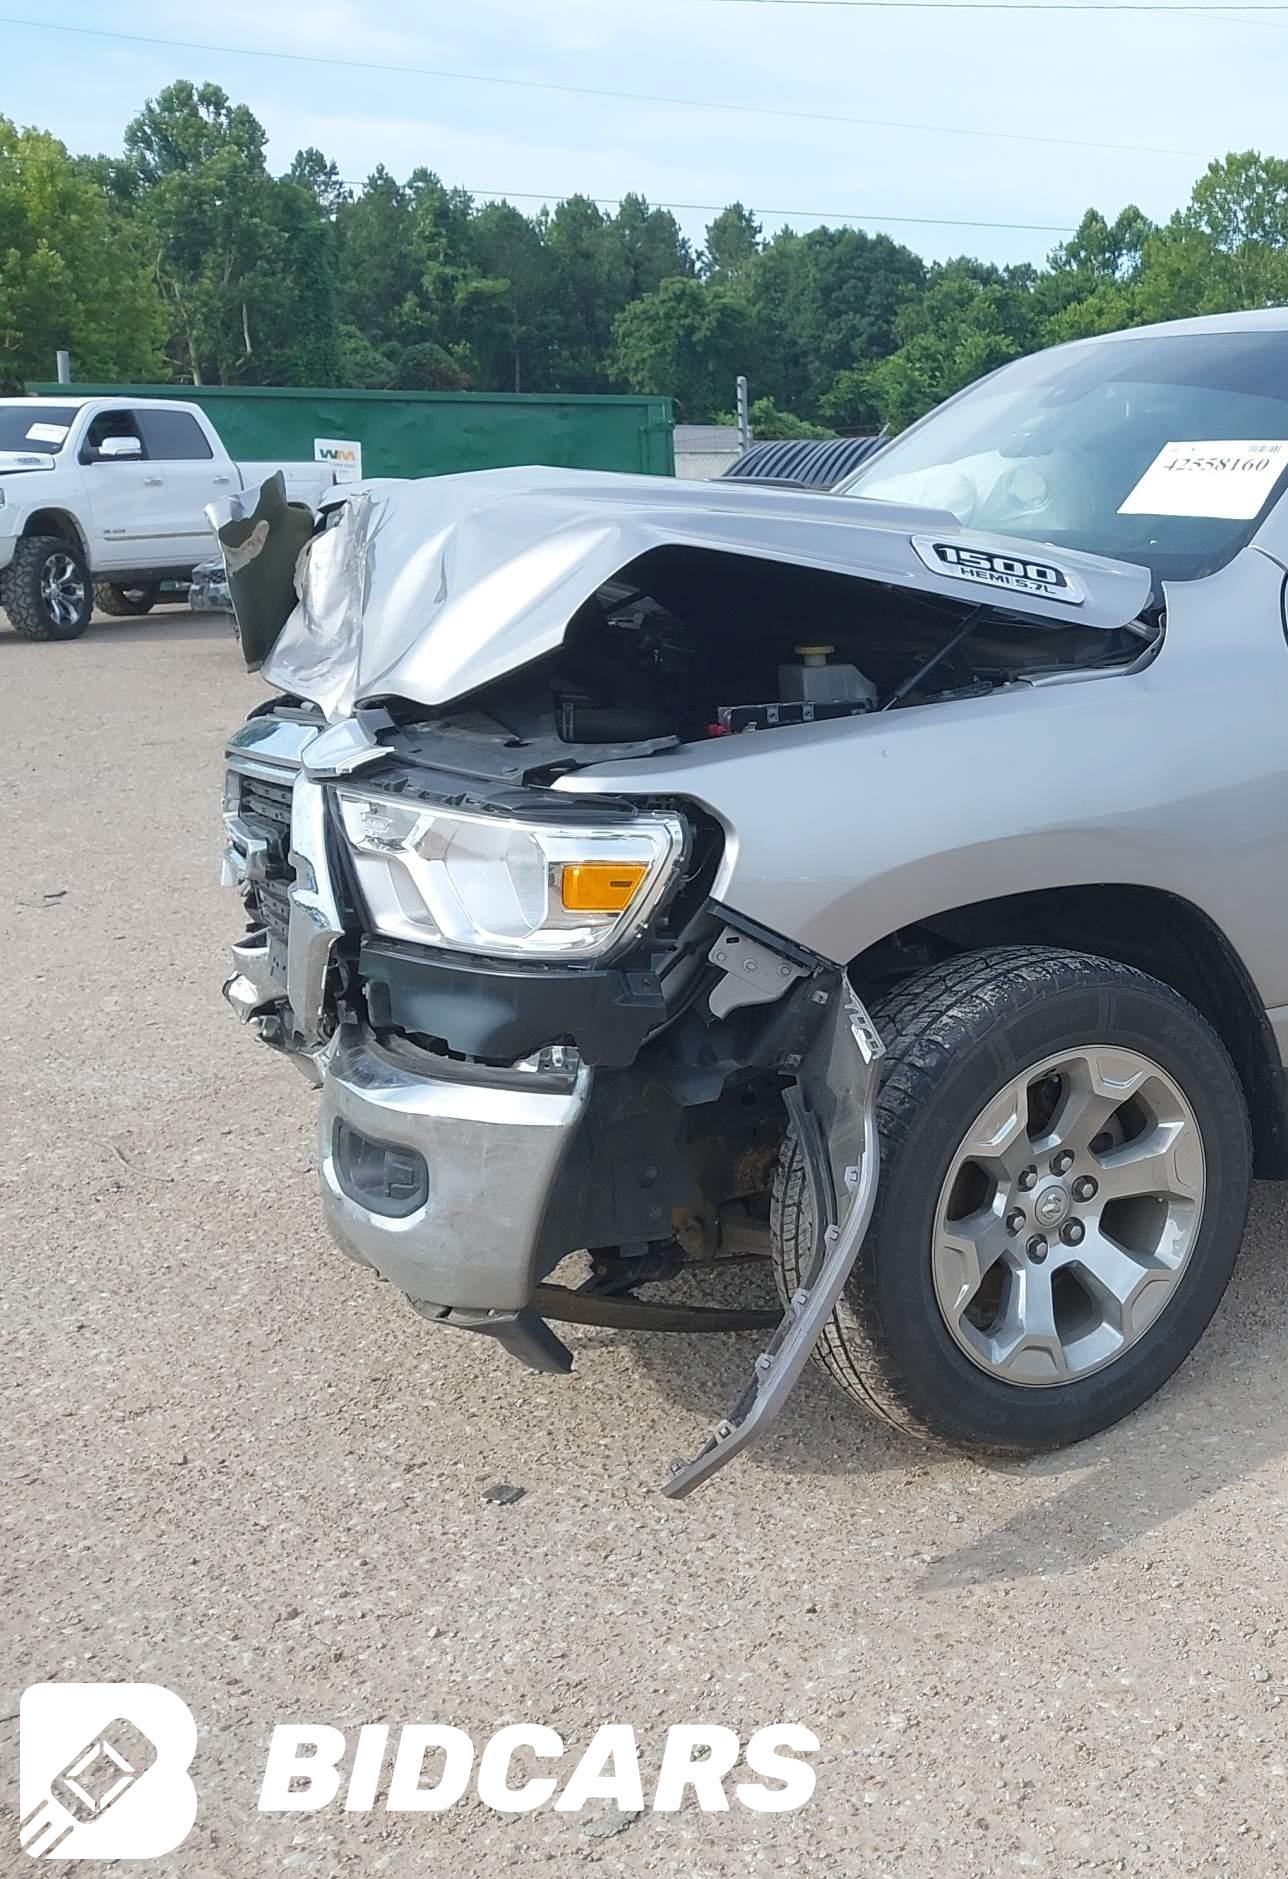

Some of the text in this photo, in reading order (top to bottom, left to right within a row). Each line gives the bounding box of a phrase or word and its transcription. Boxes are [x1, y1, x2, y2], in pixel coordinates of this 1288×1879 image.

[1163, 457, 1271, 472] 42558160
[938, 547, 1057, 584] 1500
[960, 567, 1057, 595] HEMI 5.7L
